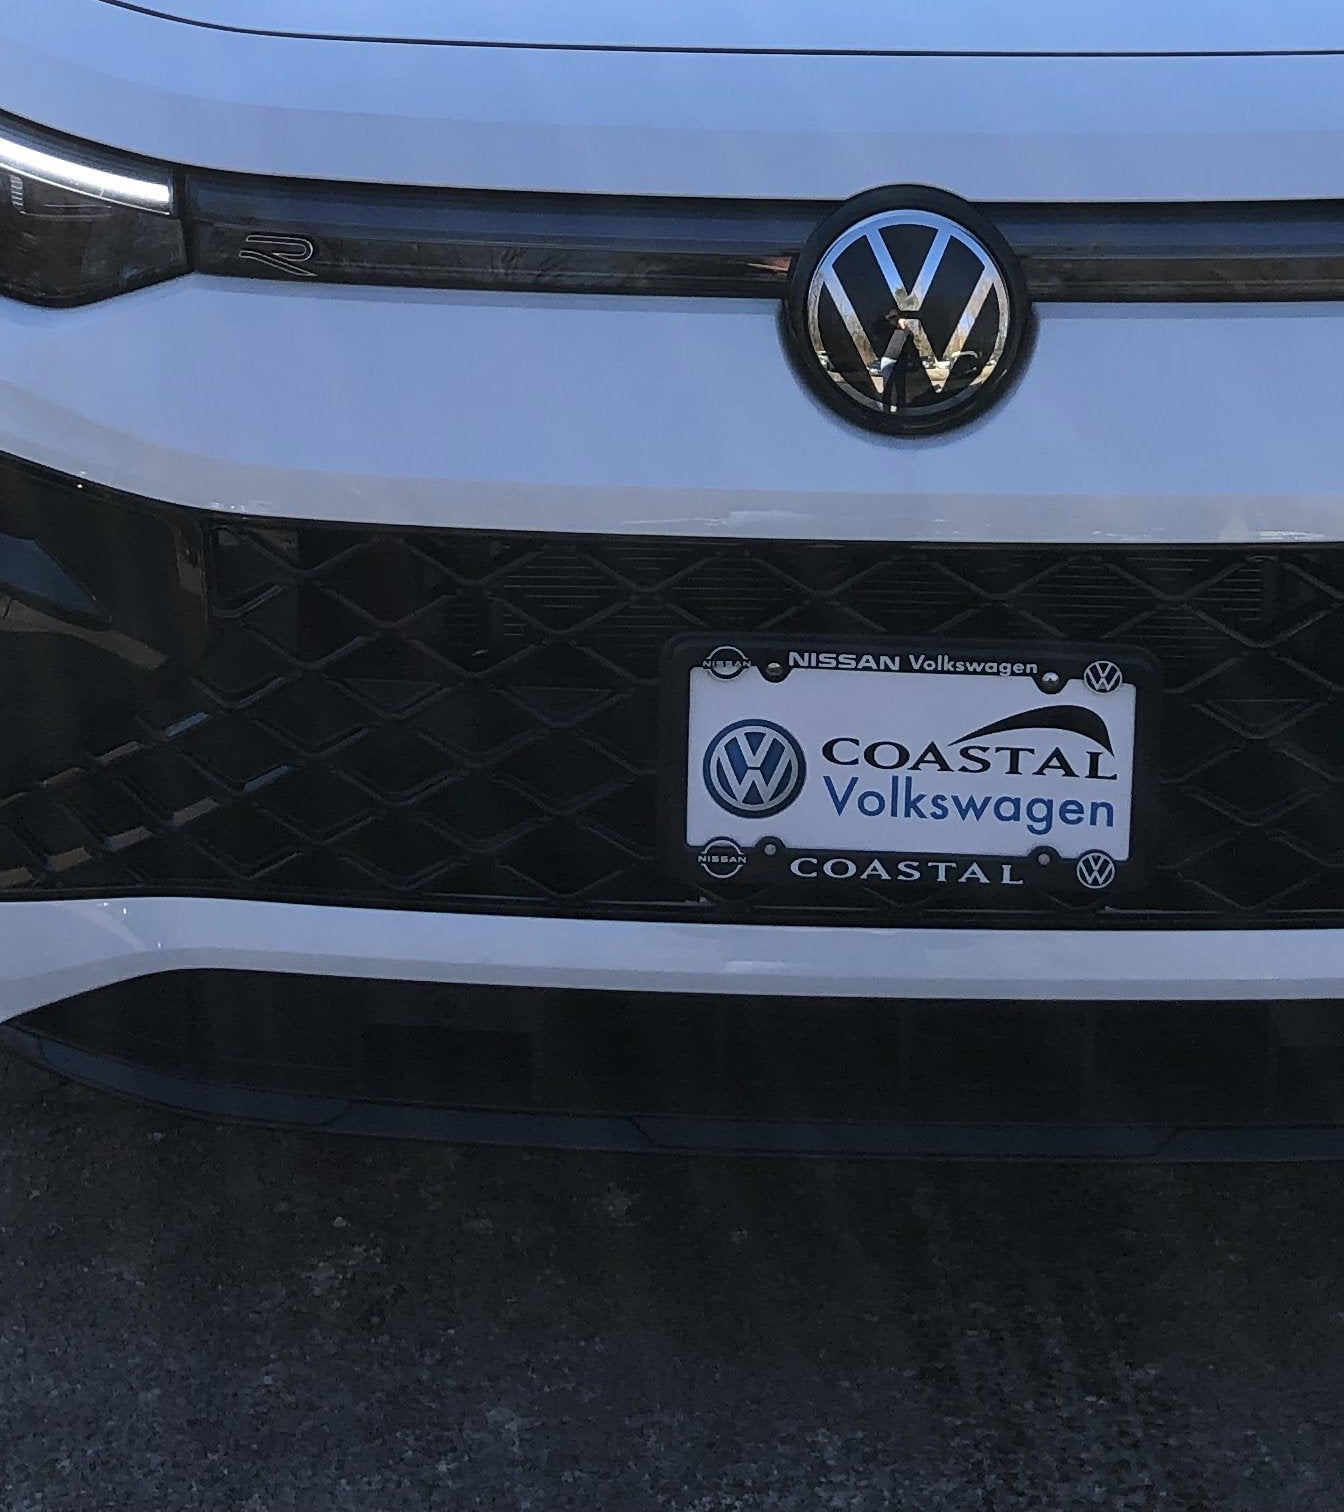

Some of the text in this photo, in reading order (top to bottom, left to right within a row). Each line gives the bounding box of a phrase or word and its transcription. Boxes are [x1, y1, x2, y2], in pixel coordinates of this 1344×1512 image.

[702, 659, 752, 669] NISSAN
[788, 651, 1038, 677] NISSAN Volkswagen
[821, 737, 1118, 780] COASTAL
[822, 775, 1115, 836] Volkswagen
[697, 855, 747, 864] NISSAN
[789, 857, 1024, 885] COASTAL
